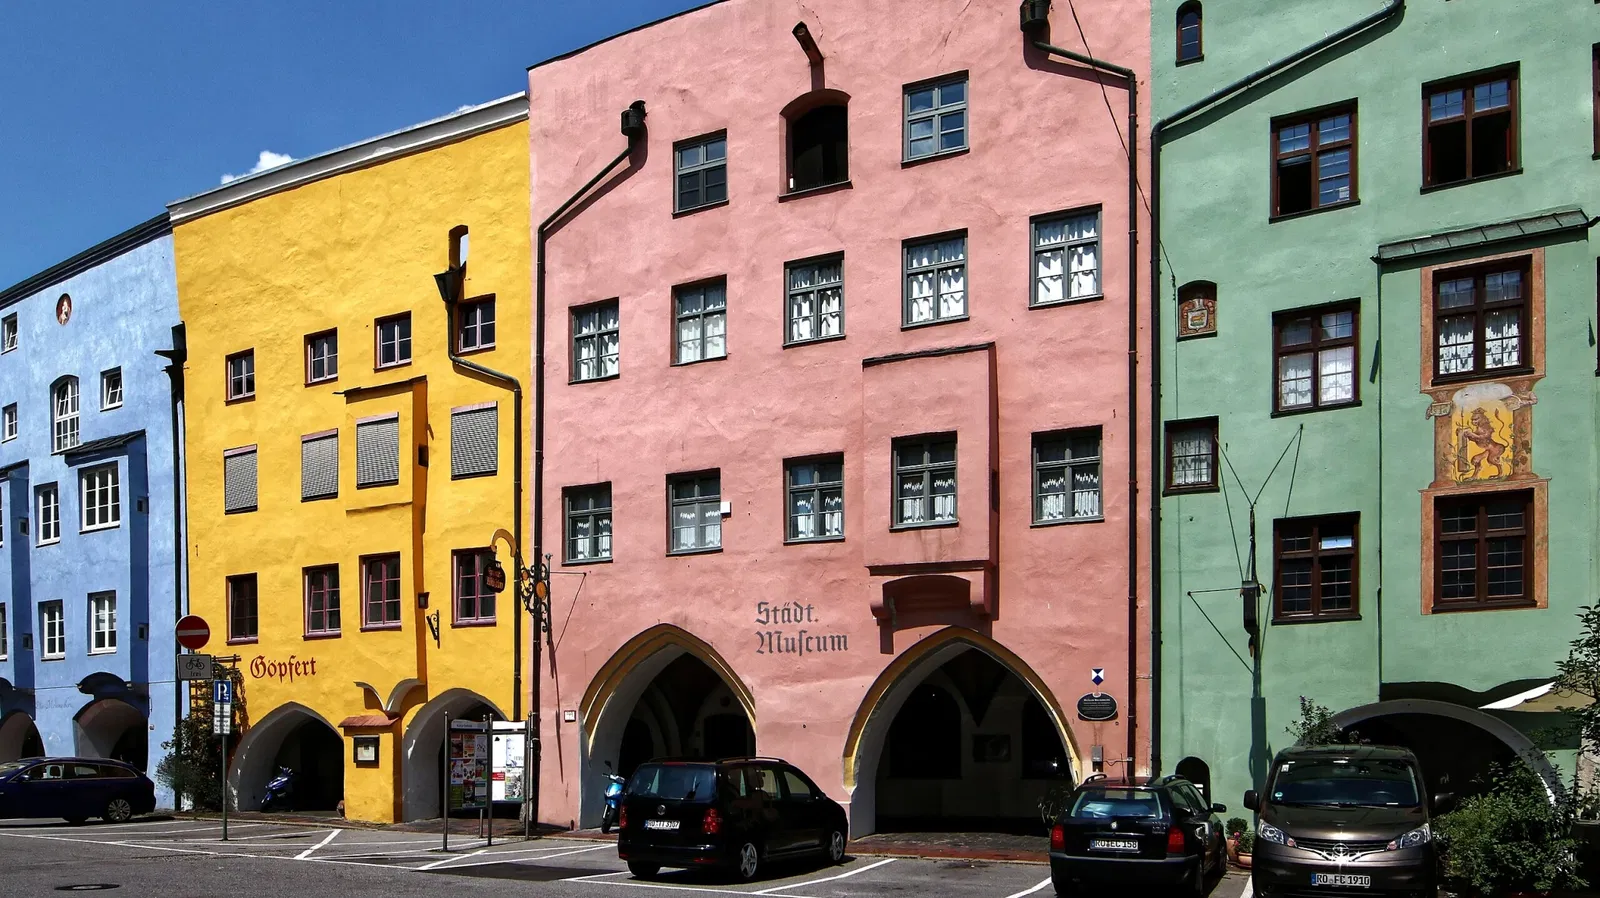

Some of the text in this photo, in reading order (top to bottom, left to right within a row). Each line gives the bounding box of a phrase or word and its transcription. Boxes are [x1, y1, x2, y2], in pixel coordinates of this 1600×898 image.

[755, 601, 819, 625] Städt.
[250, 655, 316, 683] Göpfert
[217, 683, 228, 701] P
[1316, 874, 1370, 885] RO FC 1910
